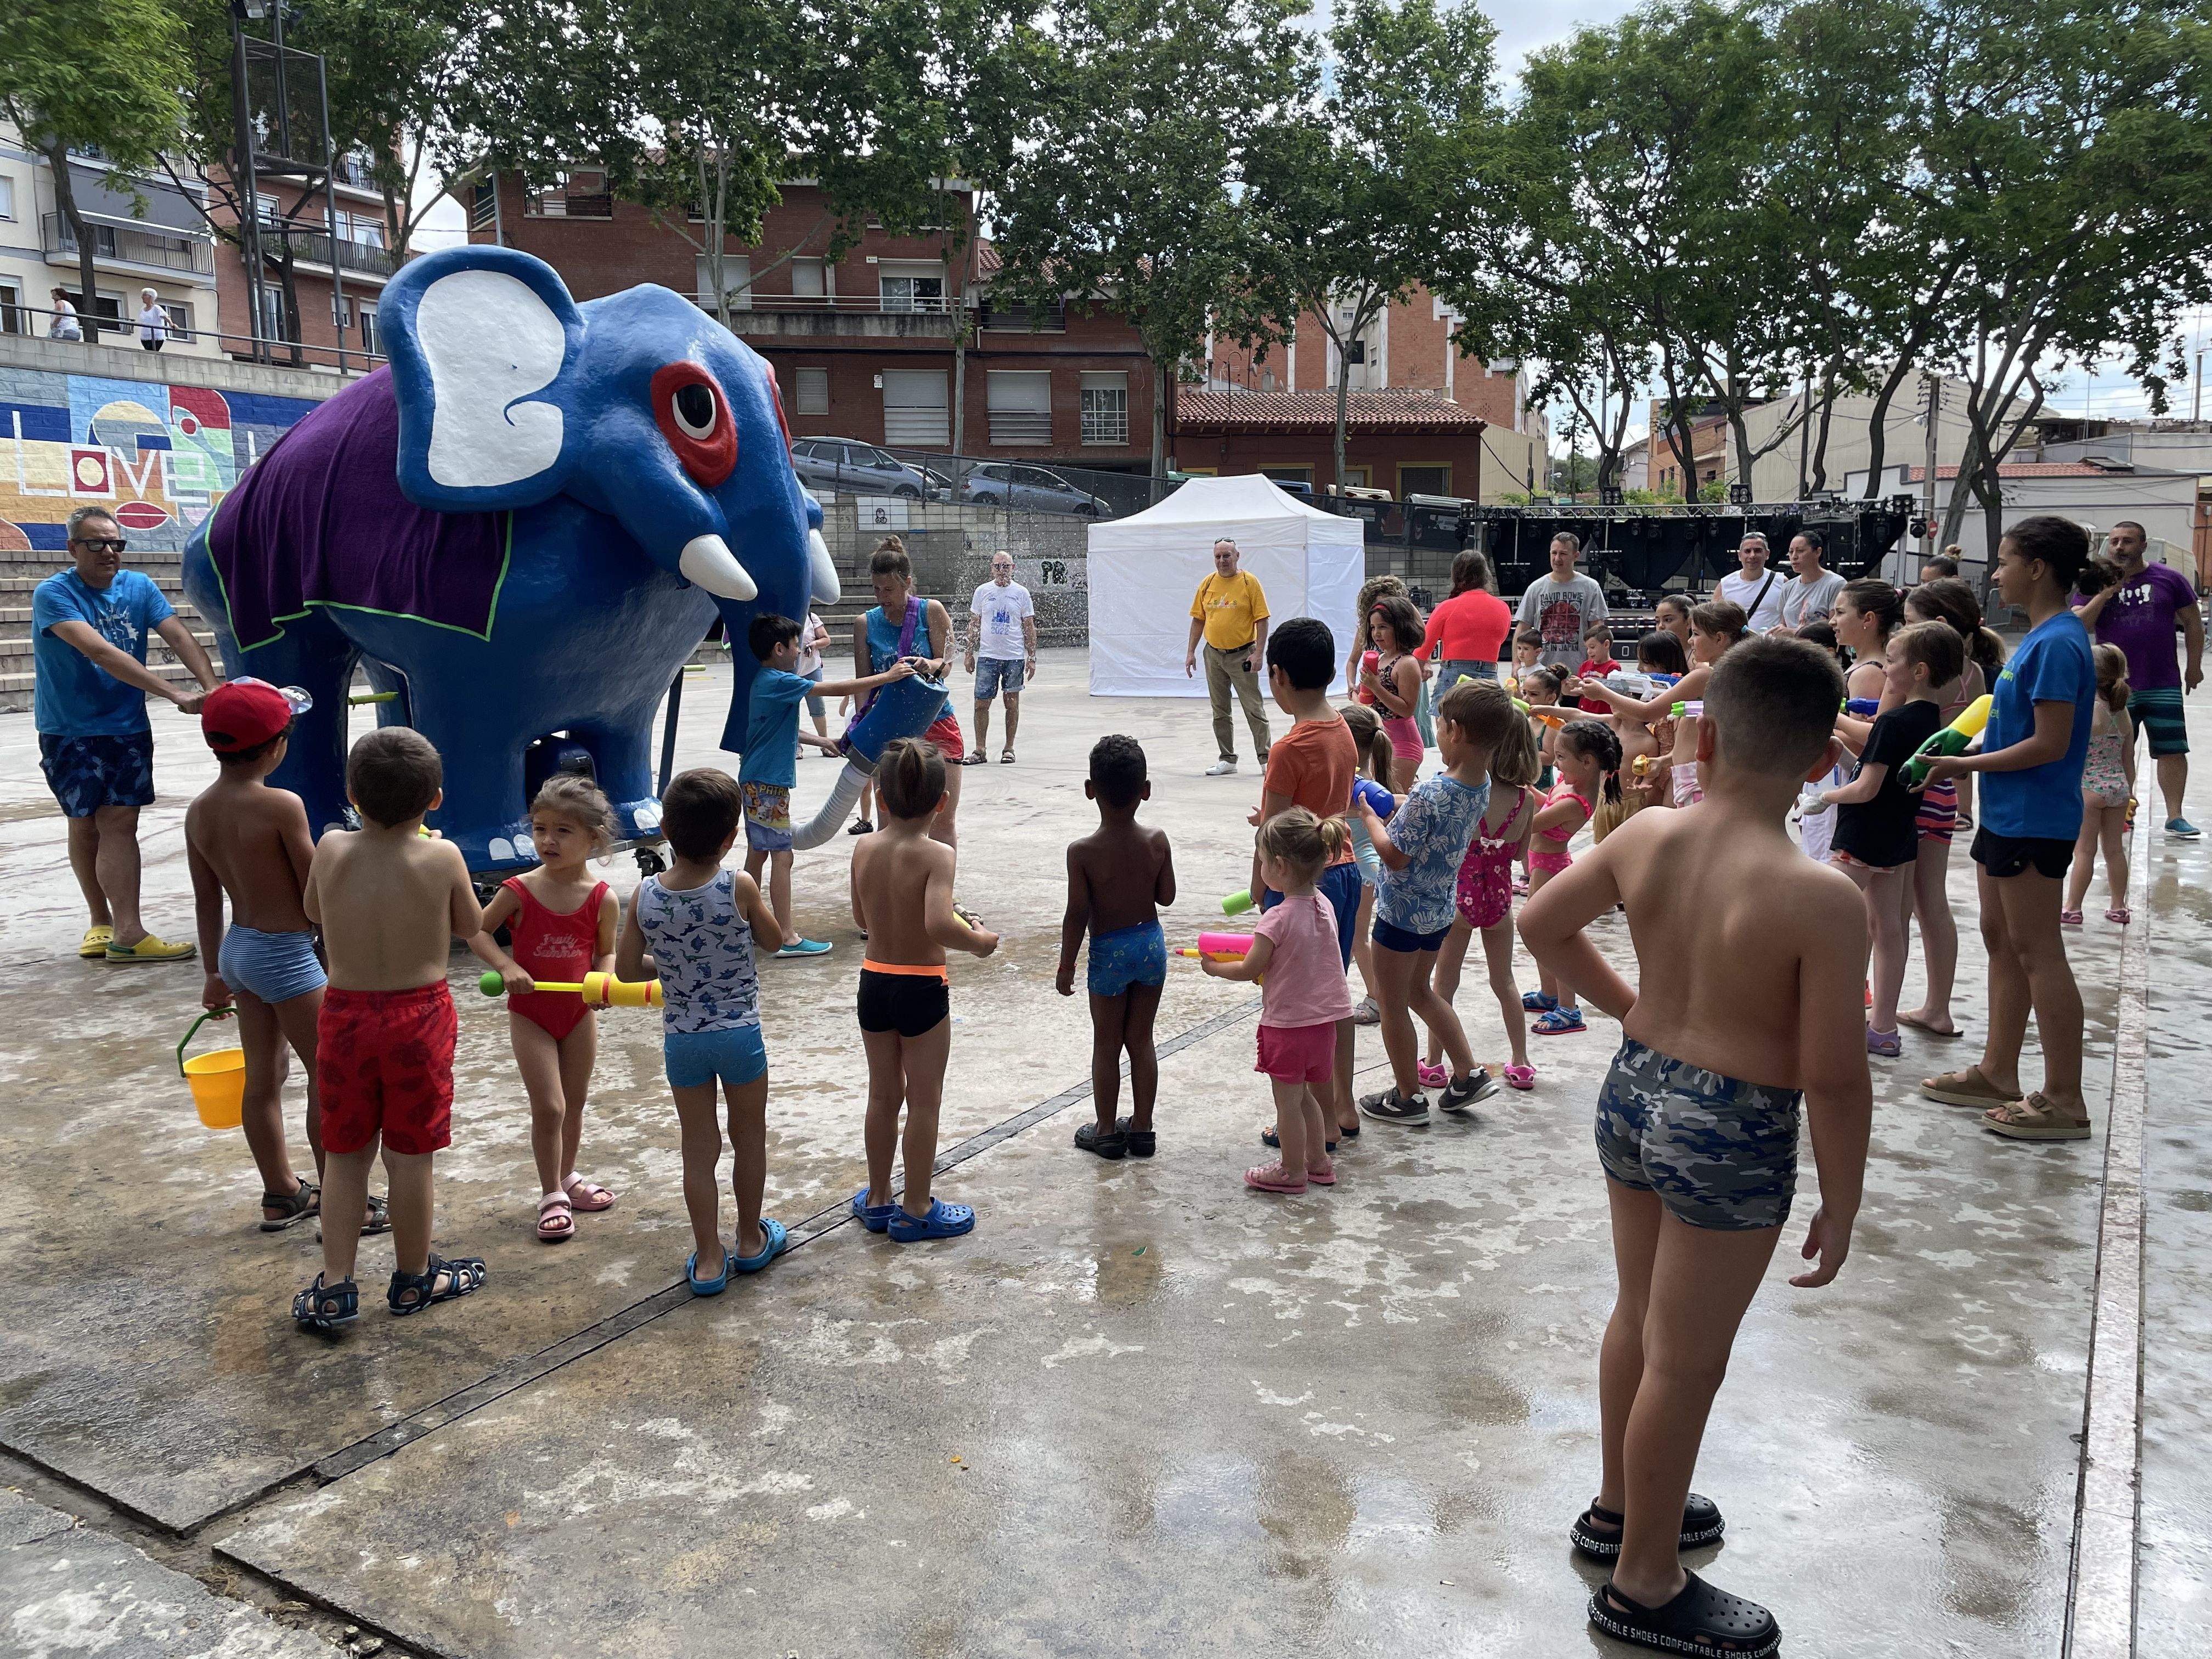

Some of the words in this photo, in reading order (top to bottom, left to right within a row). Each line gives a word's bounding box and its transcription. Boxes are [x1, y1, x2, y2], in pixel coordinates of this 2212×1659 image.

[1540, 591, 1561, 602] DAVID
[1562, 591, 1584, 601] BOWIE
[991, 626, 1009, 635] 2022
[1551, 644, 1557, 652] IN
[1559, 644, 1578, 652] JAPAN
[1700, 1526, 1719, 1540] SHOES
[1589, 1602, 1628, 1637] FORTABLE
[1630, 1627, 1658, 1644] SHOES
[1660, 1635, 1722, 1658] COMFORTABLE
[1724, 1650, 1752, 1659] SHOES
